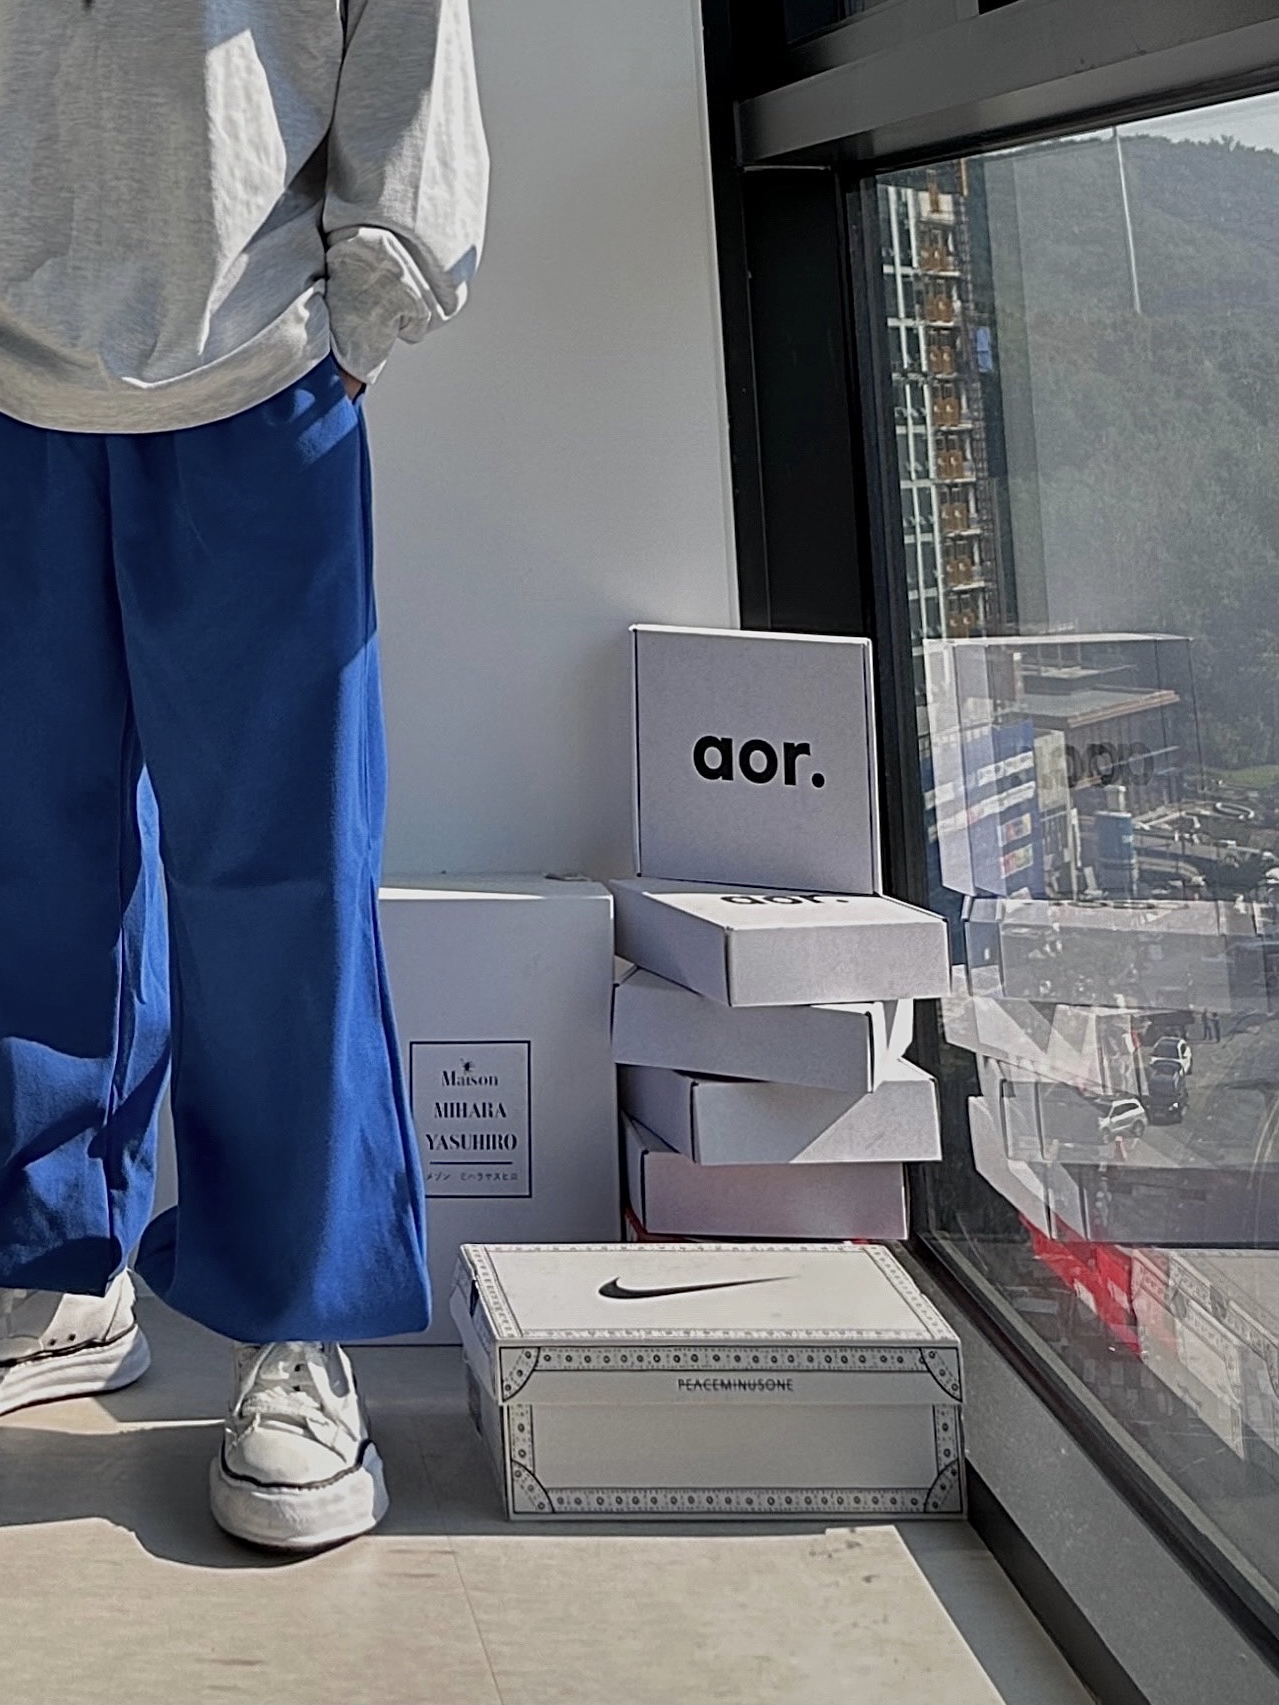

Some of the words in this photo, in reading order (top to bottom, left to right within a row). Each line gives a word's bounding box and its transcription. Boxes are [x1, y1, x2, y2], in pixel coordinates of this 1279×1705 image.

[693, 735, 825, 788] aor.
[441, 1070, 499, 1087] Maison
[434, 1102, 507, 1119] MIHARA
[425, 1133, 518, 1151] YASUHIRO
[677, 1378, 795, 1392] PEACEMINUSONE
